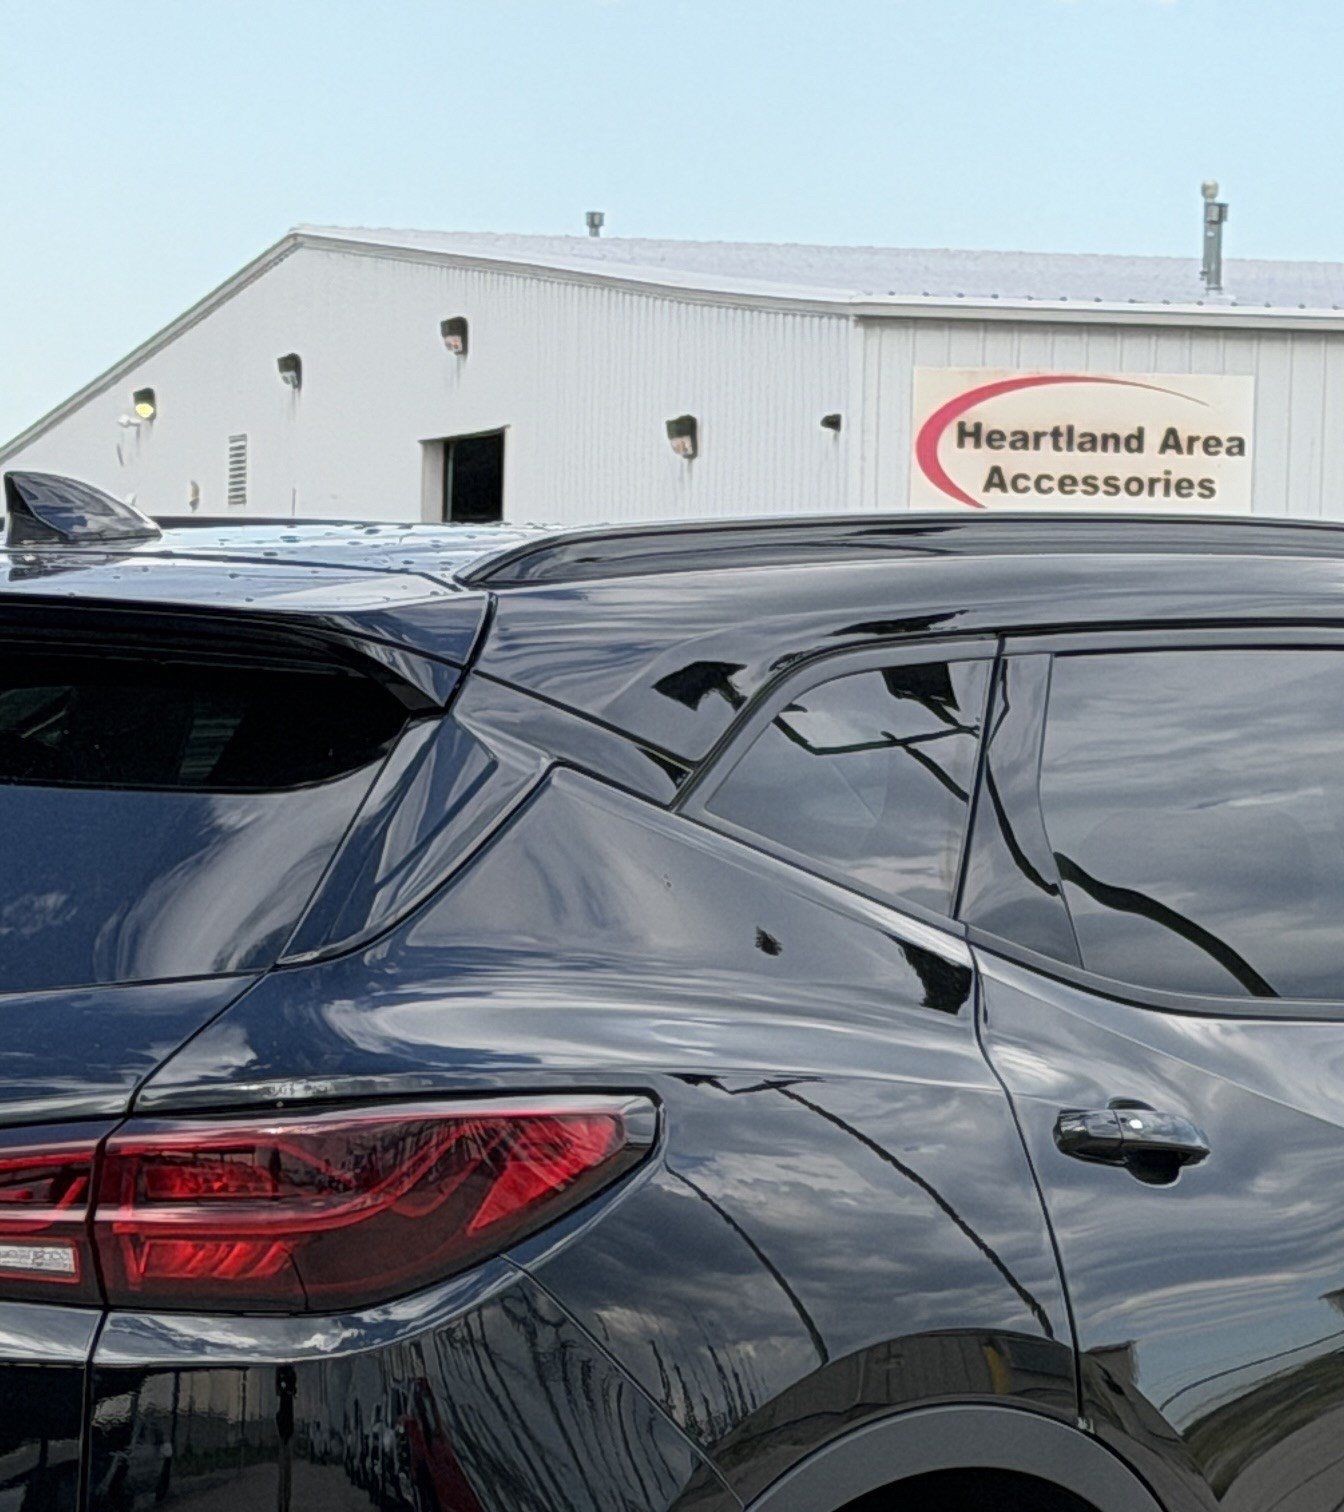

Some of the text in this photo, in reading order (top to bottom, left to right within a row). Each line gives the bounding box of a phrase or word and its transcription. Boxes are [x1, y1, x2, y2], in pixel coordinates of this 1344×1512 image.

[957, 421, 1246, 457] Heartland Area
[982, 465, 1217, 500] Accessories
